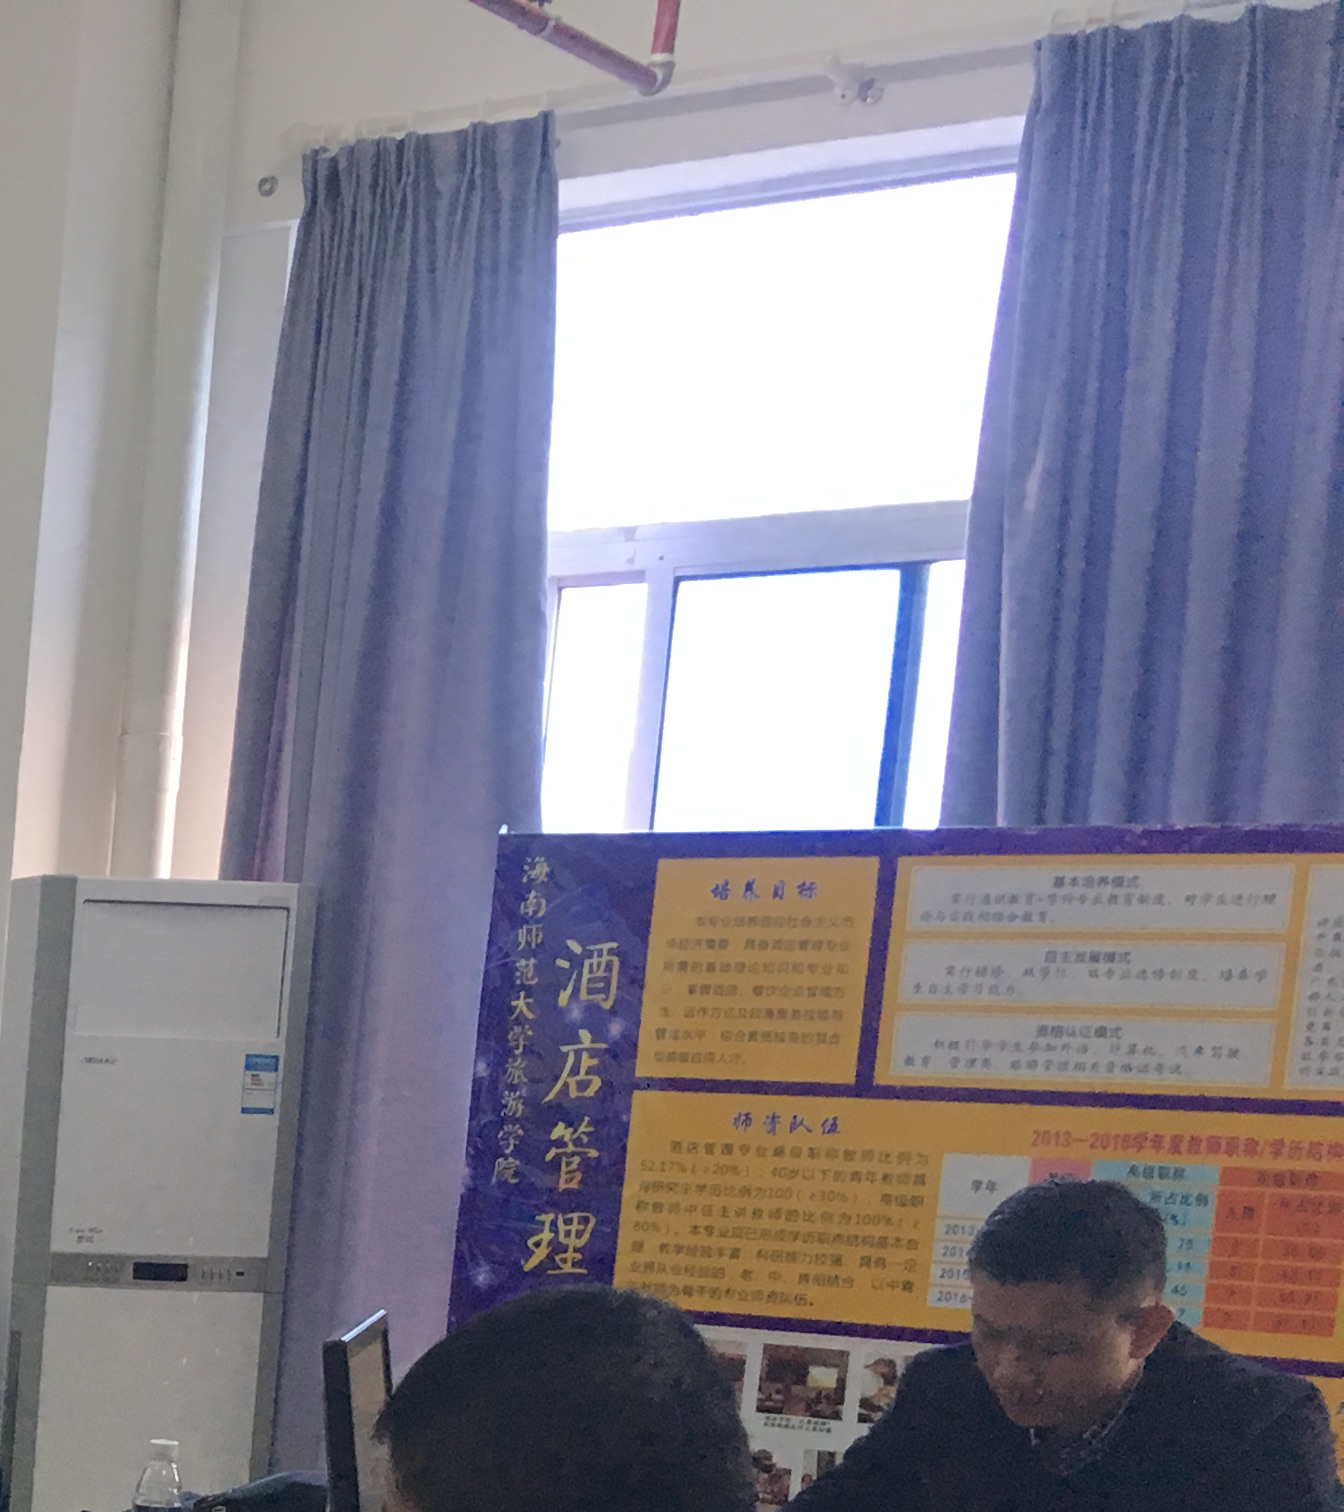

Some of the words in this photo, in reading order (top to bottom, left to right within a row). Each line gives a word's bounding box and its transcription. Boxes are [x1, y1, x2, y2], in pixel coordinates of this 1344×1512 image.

[710, 878, 819, 901] 培养目标
[491, 856, 550, 1185] 海南师范大学旅游学院
[522, 938, 621, 1276] 酒店管理
[732, 1111, 842, 1135] 师资队伍
[971, 1179, 998, 1194] 学年
